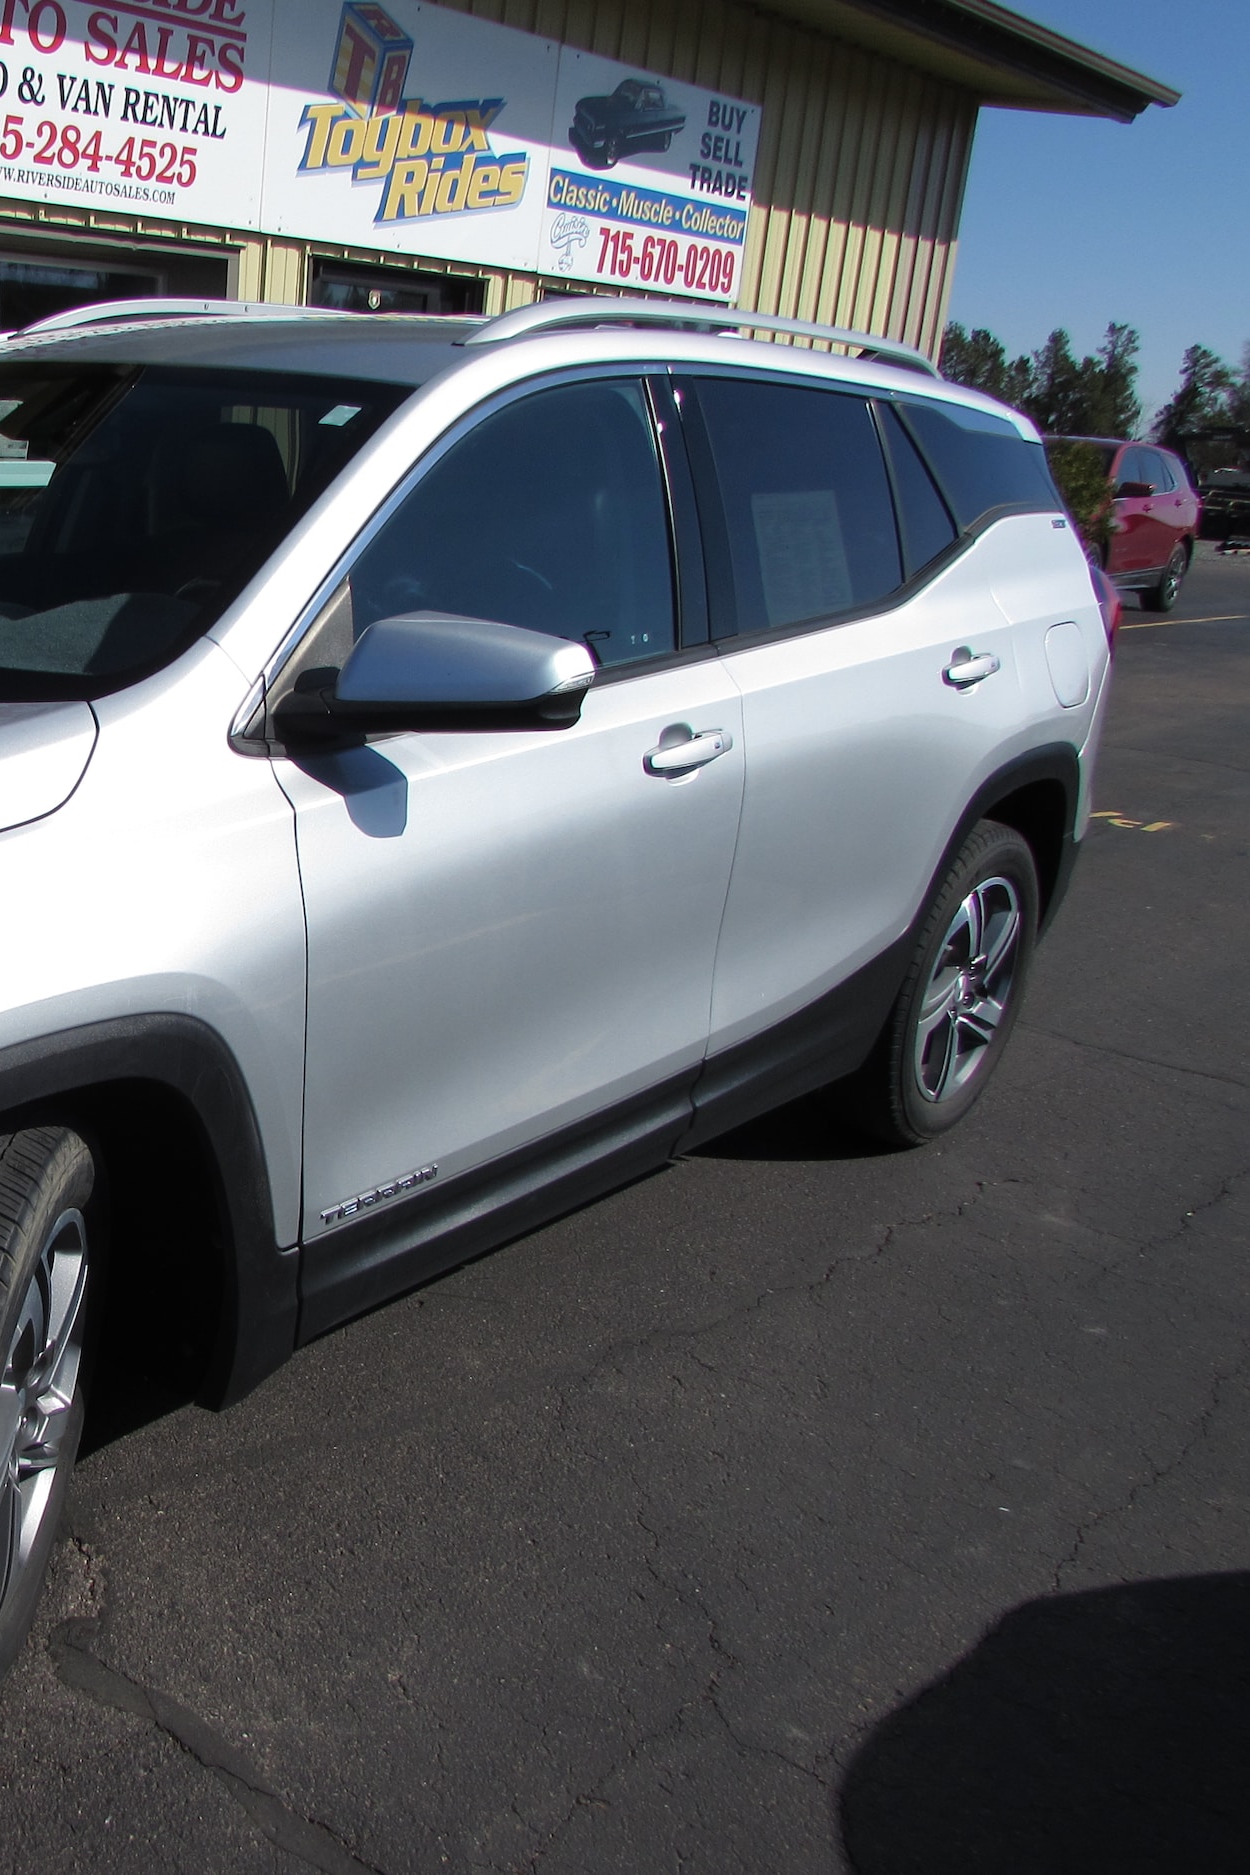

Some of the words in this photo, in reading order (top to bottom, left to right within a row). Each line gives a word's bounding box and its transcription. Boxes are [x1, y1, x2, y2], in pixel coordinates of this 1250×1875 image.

[84, 11, 245, 93] SALES
[17, 66, 46, 106] &
[56, 73, 115, 119] VAN
[120, 86, 227, 140] RENTAL
[707, 99, 747, 135] BUY
[300, 98, 503, 180] Toybox
[700, 132, 743, 168] SELL
[379, 152, 531, 221] Rides
[549, 174, 610, 213] Classic
[617, 190, 673, 226] Muscle
[681, 204, 746, 240] Collector
[689, 163, 748, 201] TRADE
[597, 226, 735, 295] 715-670-0209
